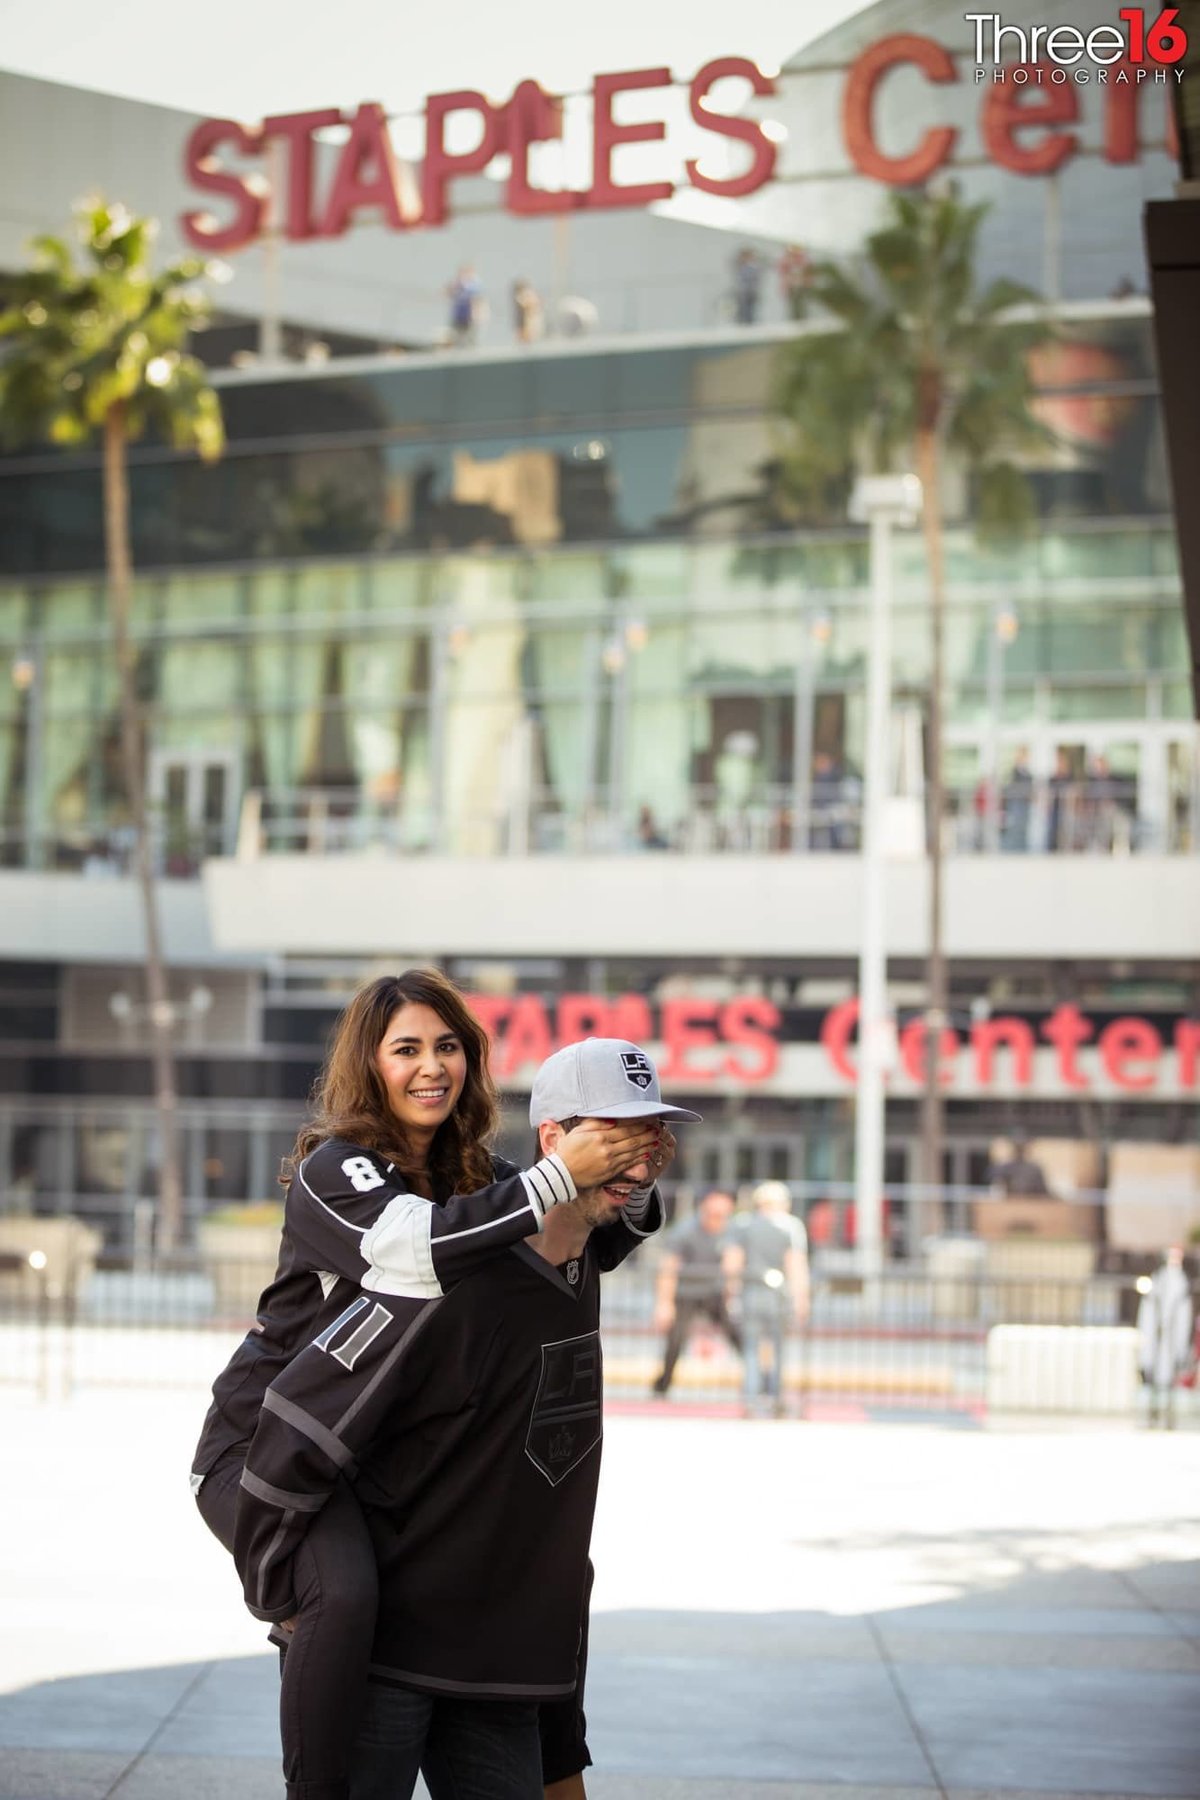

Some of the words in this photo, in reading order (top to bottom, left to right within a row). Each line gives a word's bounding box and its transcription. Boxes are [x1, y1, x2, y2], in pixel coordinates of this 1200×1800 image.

[179, 56, 778, 253] STAPLES
[622, 1054, 649, 1069] LA
[341, 1156, 395, 1192] 8
